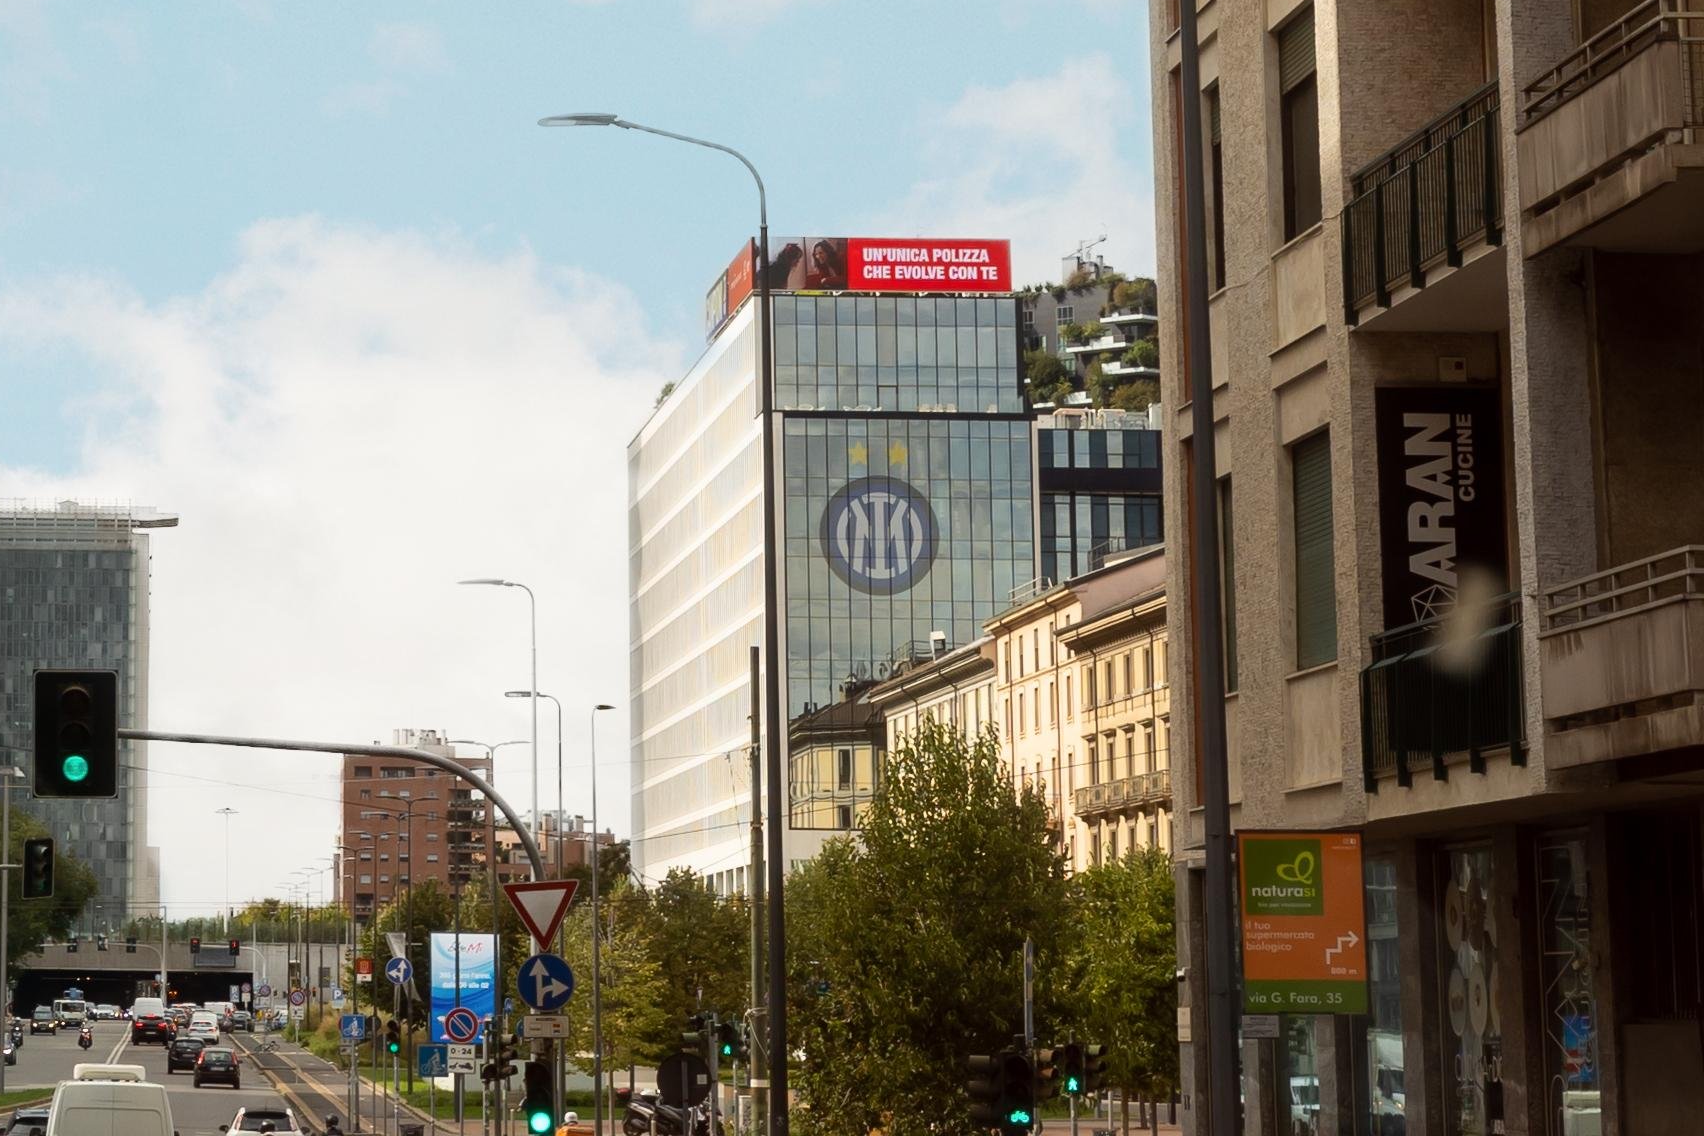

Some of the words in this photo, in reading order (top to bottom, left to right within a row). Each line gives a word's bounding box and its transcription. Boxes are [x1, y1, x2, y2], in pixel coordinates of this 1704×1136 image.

[932, 248, 990, 263] POLIZZA
[863, 265, 891, 279] CHE
[895, 265, 945, 280] EVOLVE
[948, 266, 978, 280] CON
[980, 266, 998, 281] TE
[1457, 414, 1476, 502] CUCINE
[1404, 414, 1458, 589] ARAN
[1254, 920, 1271, 930] tuo
[1246, 930, 1315, 942] supermercato
[1246, 941, 1292, 953] biologico
[333, 989, 342, 1000] P
[1249, 992, 1266, 1004] via
[1271, 992, 1286, 1004] G.
[1290, 992, 1322, 1006] Fara,
[1326, 992, 1343, 1004] 35
[463, 1048, 473, 1056] 24
